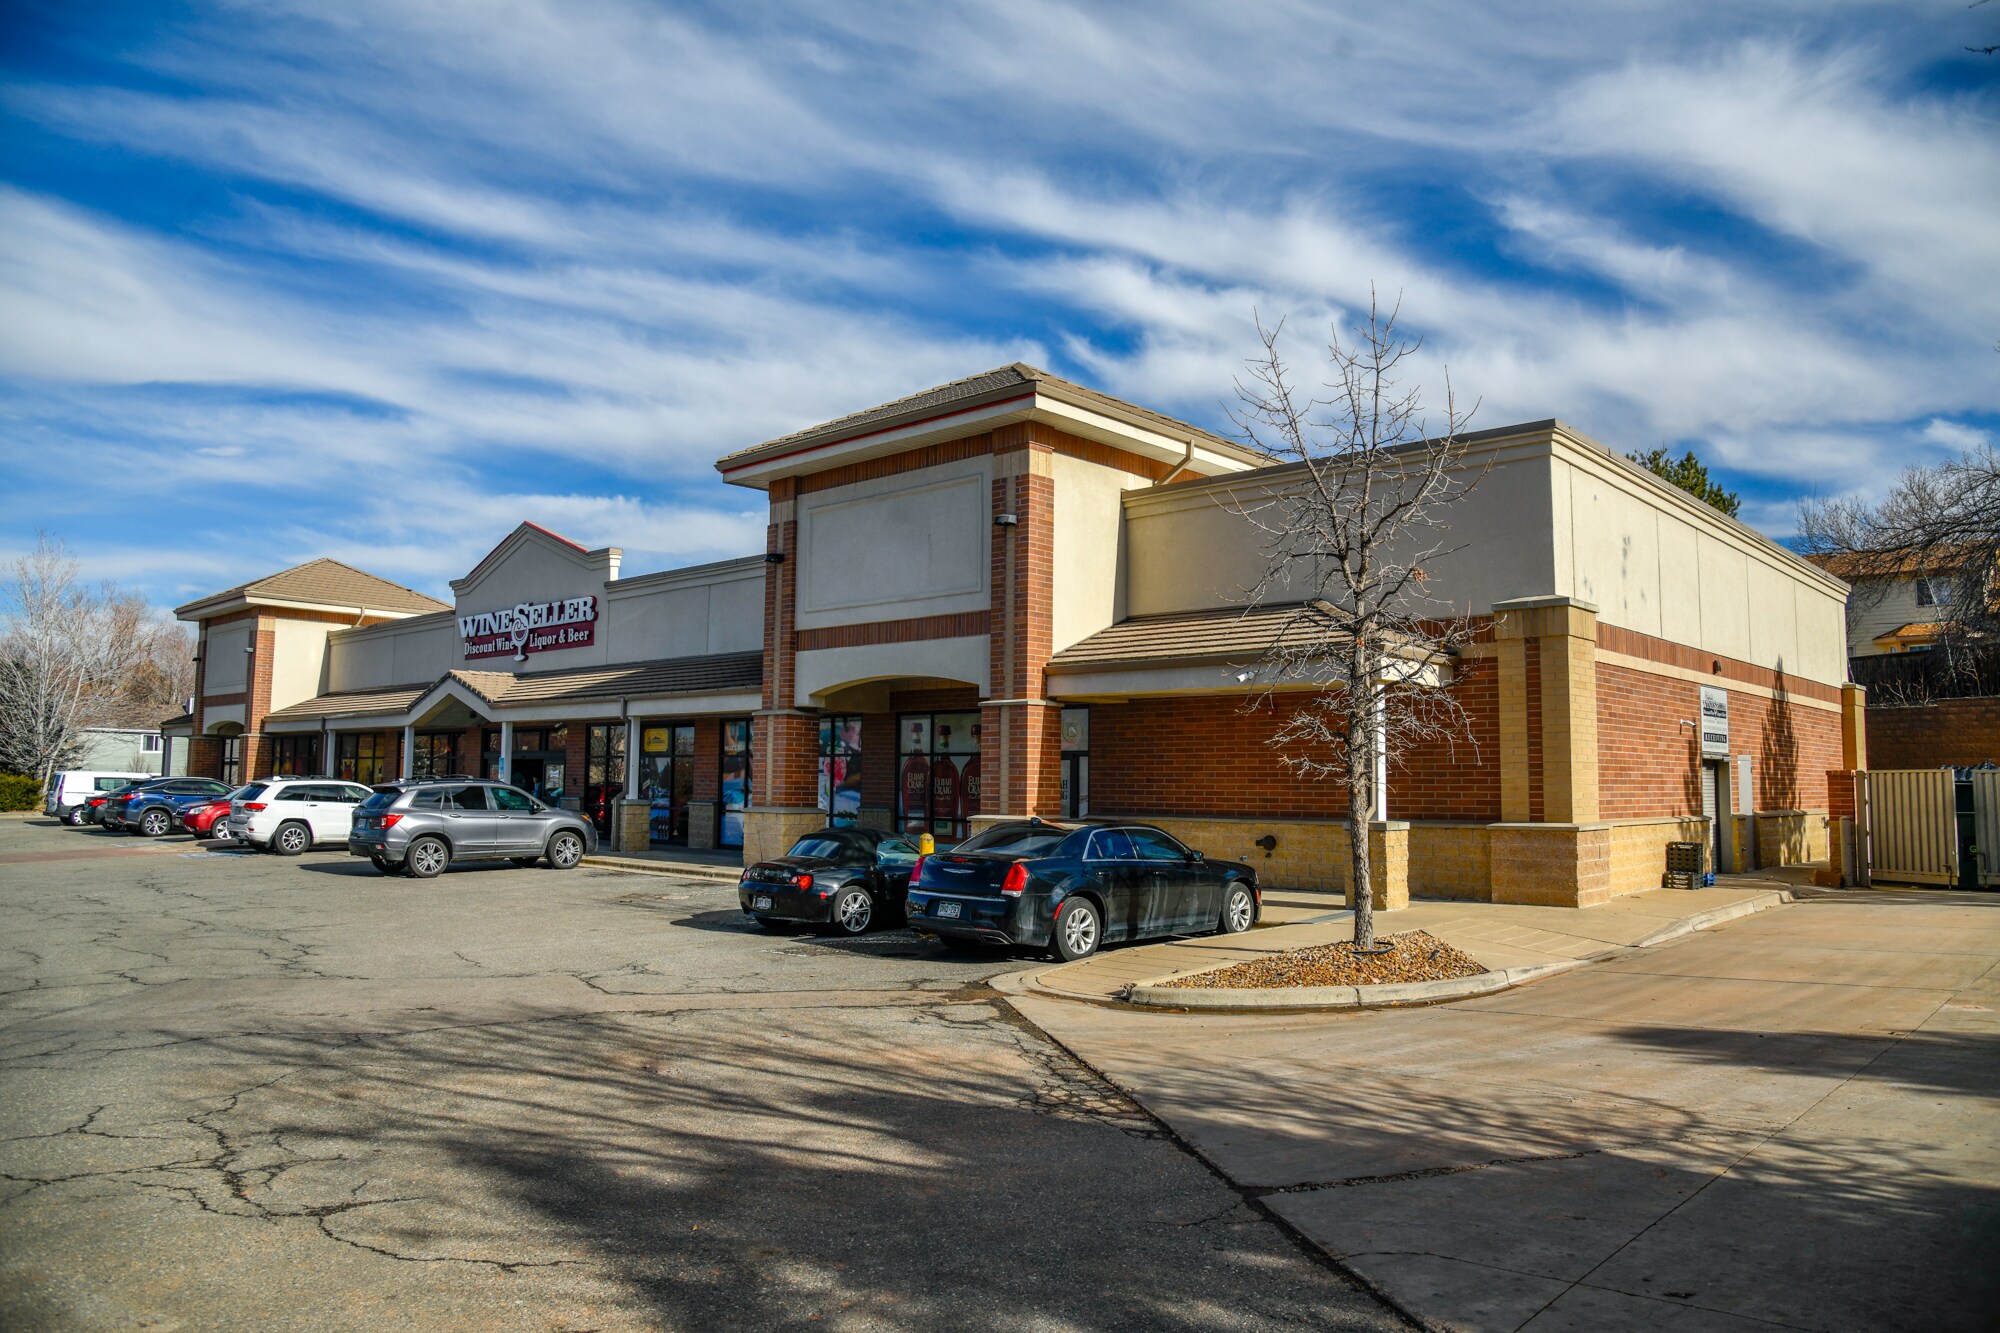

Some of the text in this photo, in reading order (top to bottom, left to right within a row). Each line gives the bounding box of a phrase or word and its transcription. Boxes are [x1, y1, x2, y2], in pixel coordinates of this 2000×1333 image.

[464, 628, 590, 655] Discount Wine Liquor & Beer
[1705, 733, 1726, 742] RECEIVING
[934, 785, 952, 796] CRAIG
